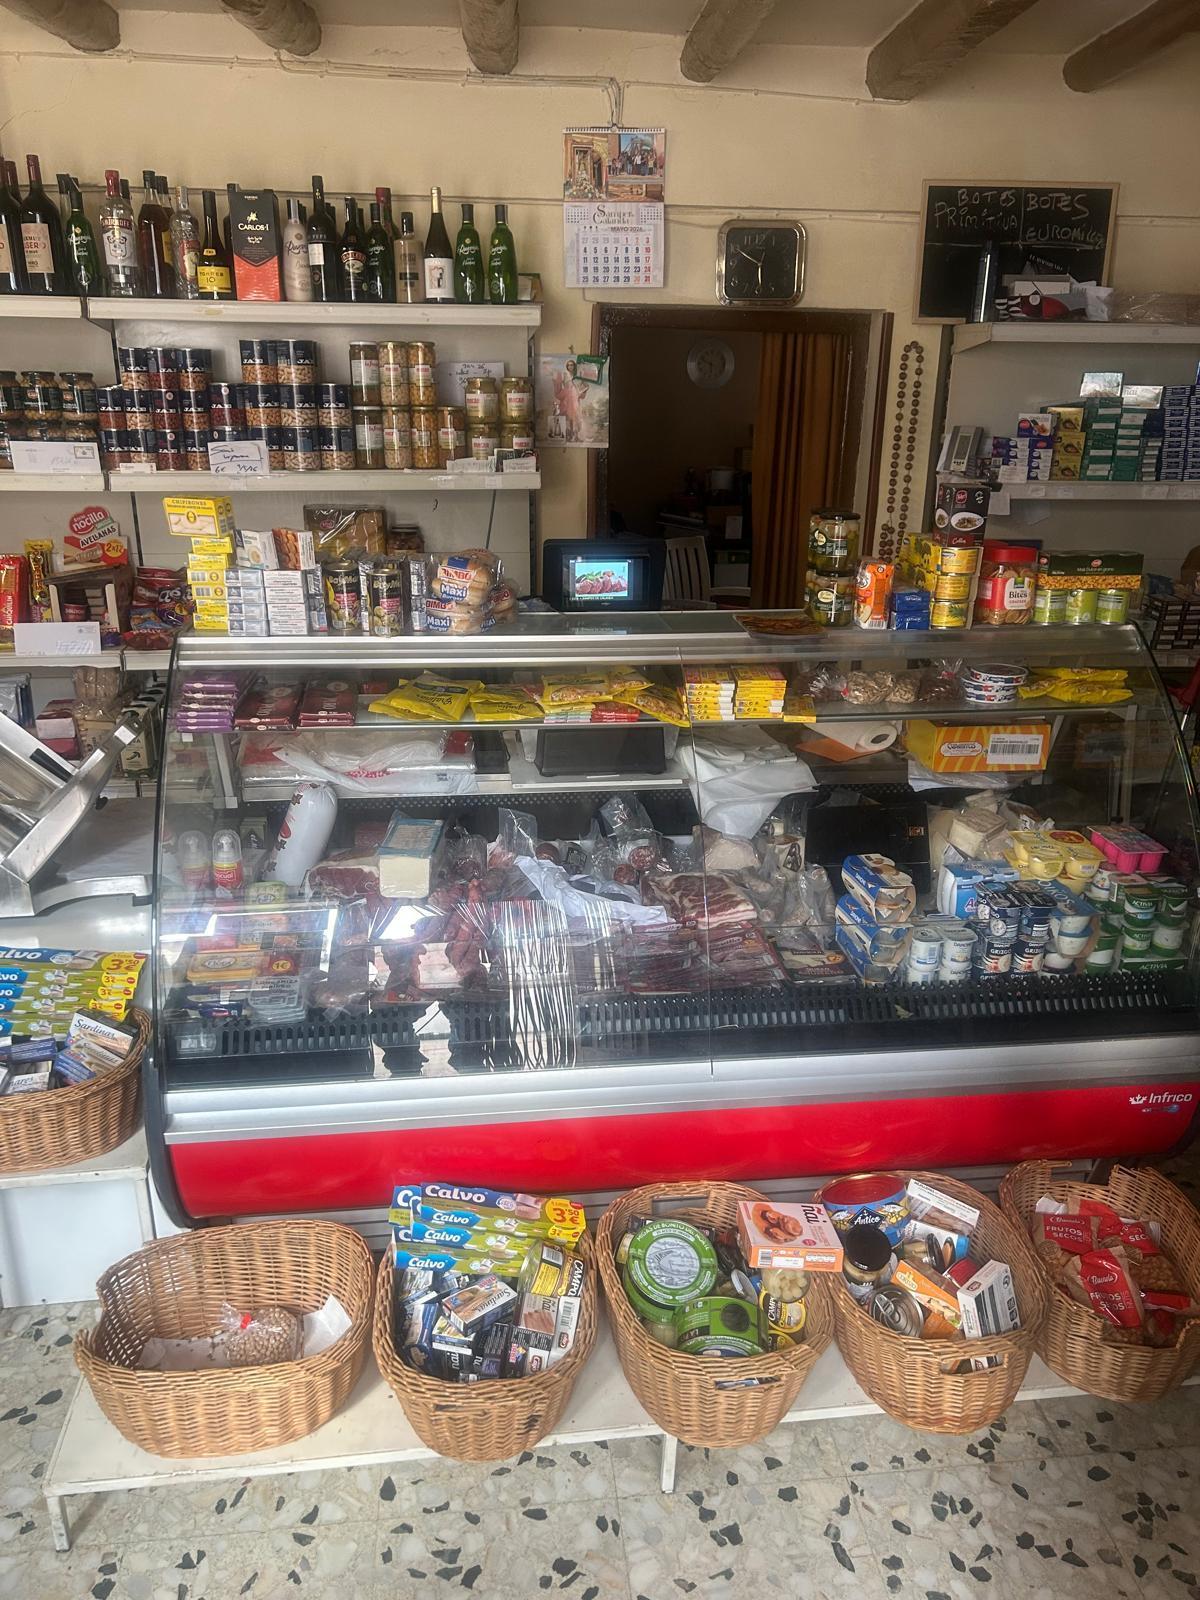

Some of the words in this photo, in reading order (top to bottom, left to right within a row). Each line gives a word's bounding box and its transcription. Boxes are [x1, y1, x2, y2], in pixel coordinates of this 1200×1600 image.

[1026, 192, 1090, 221] BOTES
[72, 511, 105, 532] nocilla
[80, 525, 117, 548] AVELLANAS
[441, 583, 467, 598] Maxi
[1008, 589, 1028, 599] Bites
[427, 615, 450, 627] Maxi
[74, 1018, 117, 1041] Sardinas
[1148, 1092, 1193, 1104] Infrico
[425, 1184, 486, 1203] Calvo
[432, 1212, 470, 1225] Calvo
[800, 1204, 827, 1225] ñai
[424, 1229, 461, 1243] Calvo
[636, 1226, 653, 1242] MIGAS
[1046, 1225, 1083, 1237] FRUTOS
[408, 1257, 446, 1269] Calvo
[476, 1286, 512, 1314] Sardinas
